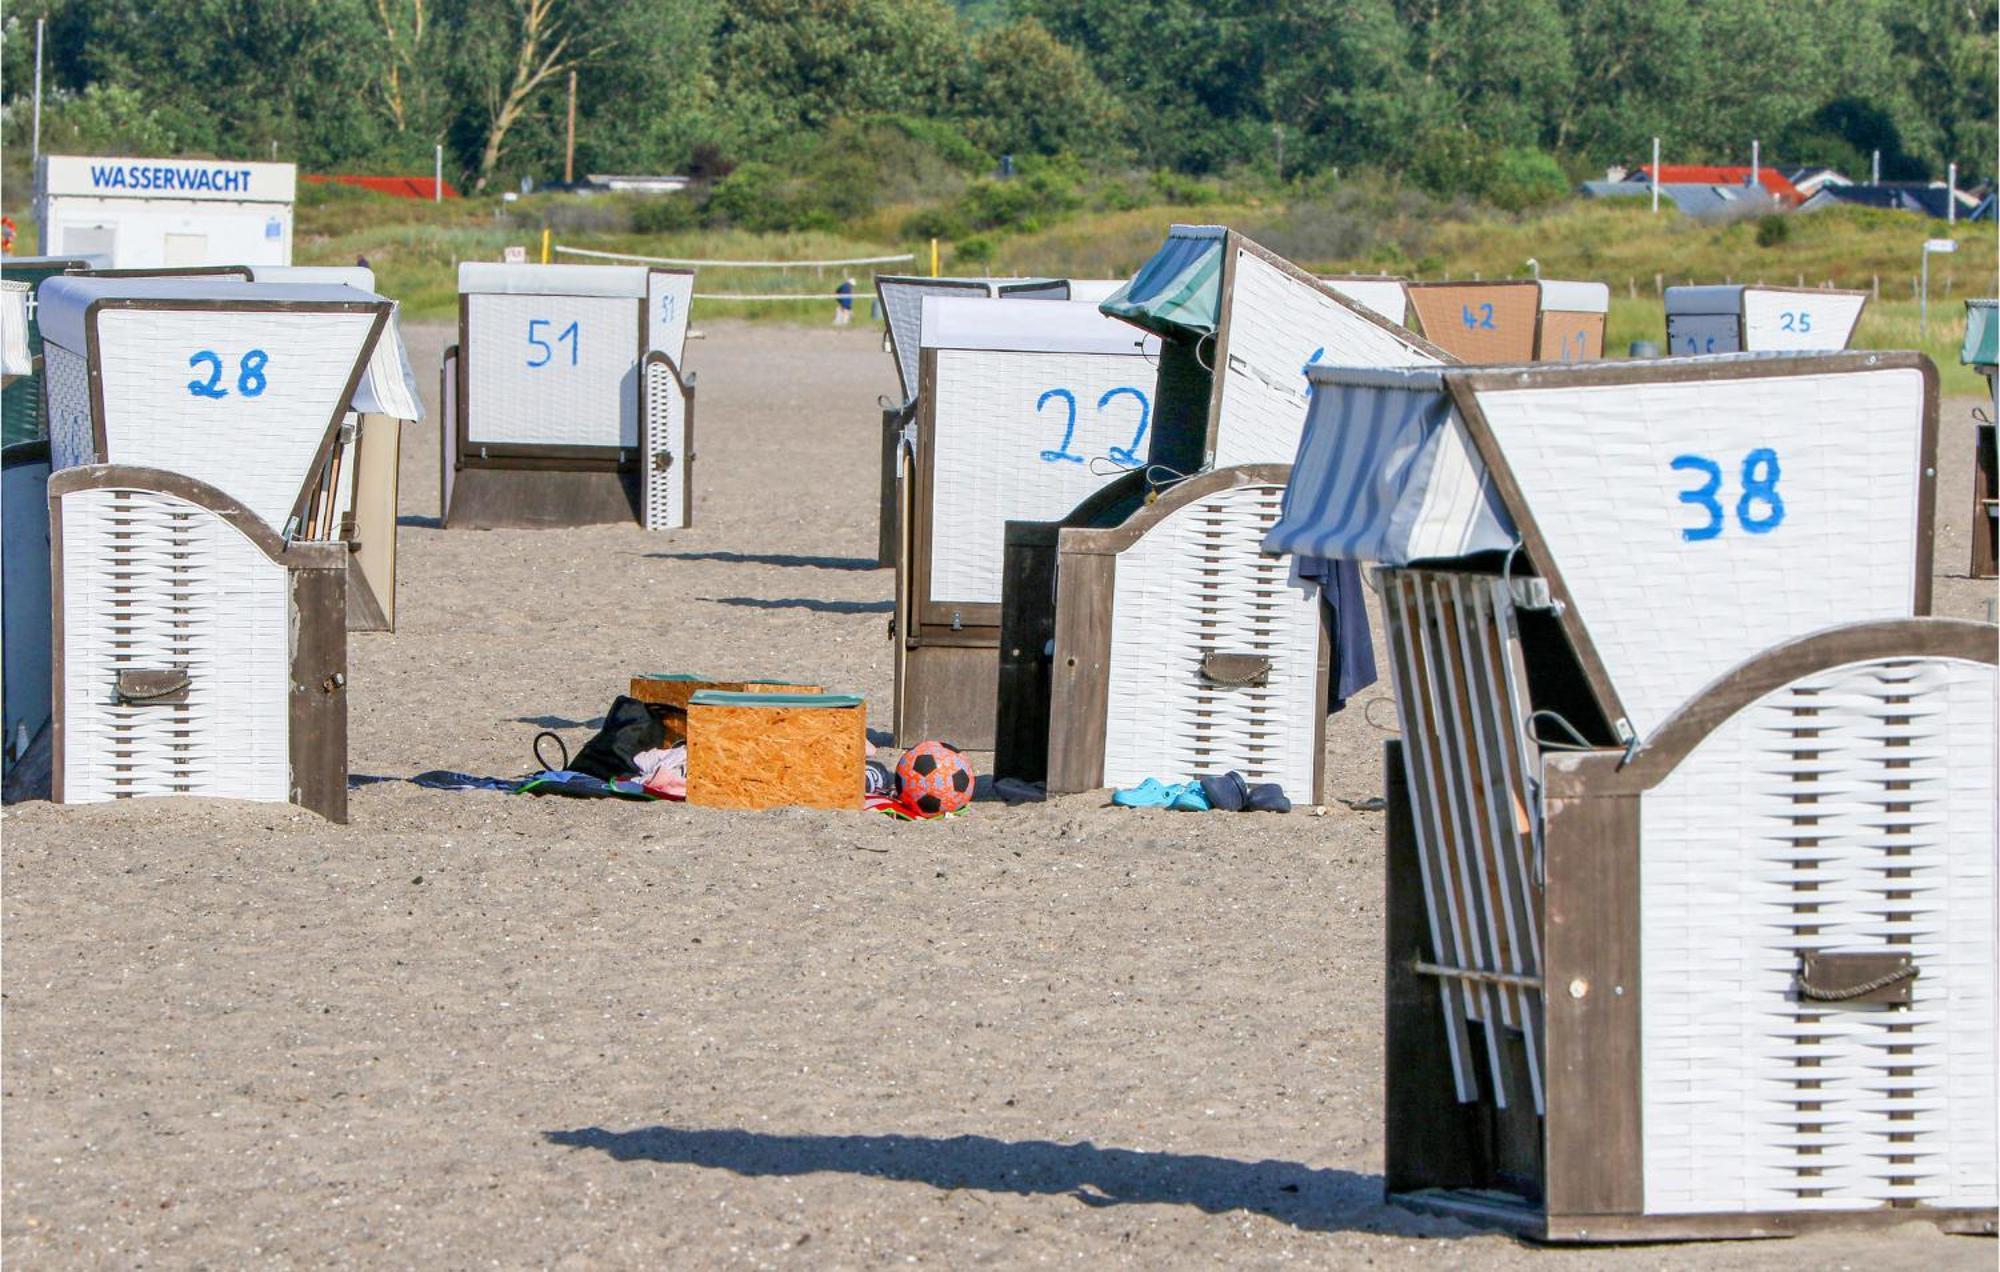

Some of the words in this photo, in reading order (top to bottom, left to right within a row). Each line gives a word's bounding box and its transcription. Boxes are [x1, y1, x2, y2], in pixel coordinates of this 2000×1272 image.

[91, 165, 251, 192] WASSERWACHT
[1462, 303, 1496, 330] 42
[1780, 311, 1811, 333] 25
[527, 319, 580, 368] 51
[188, 348, 268, 399] 28
[1036, 385, 1150, 467] 22
[1671, 448, 1785, 542] 38
